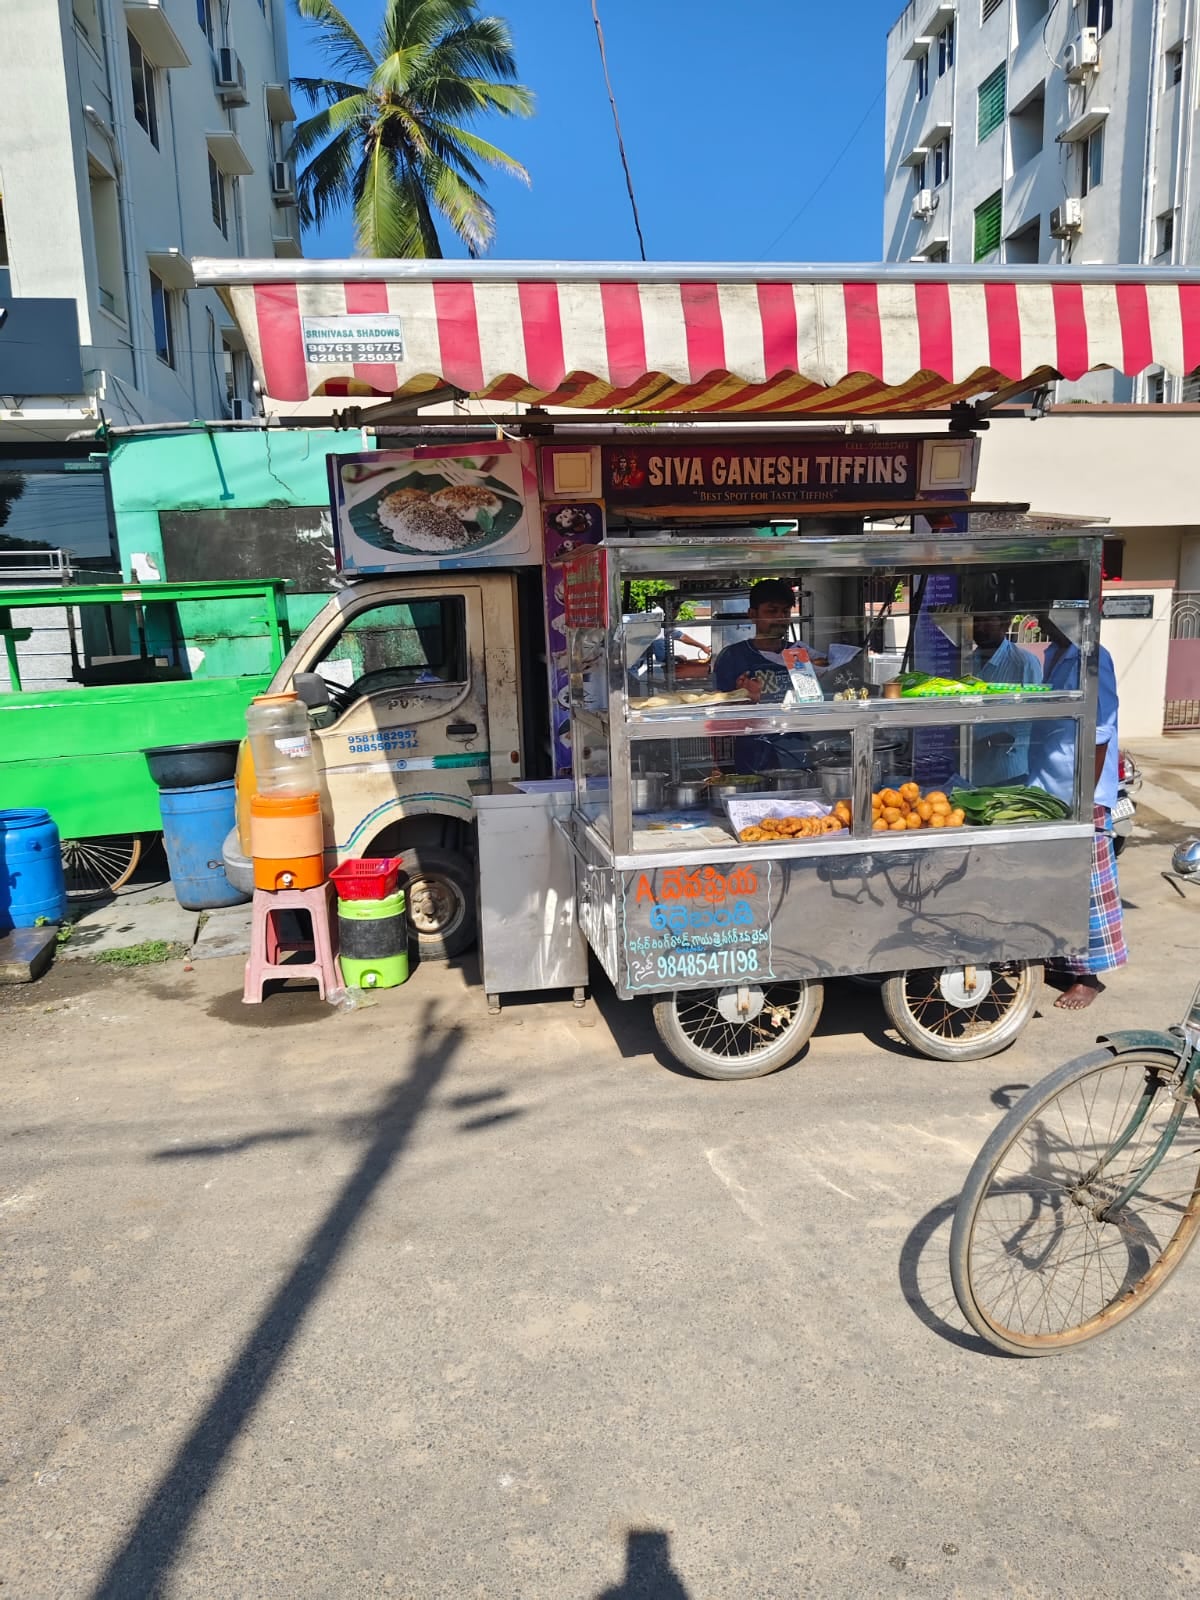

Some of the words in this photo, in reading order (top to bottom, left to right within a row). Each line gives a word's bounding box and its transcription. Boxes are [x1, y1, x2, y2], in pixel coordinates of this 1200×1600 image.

[306, 329, 354, 338] SRINIVASA
[356, 328, 400, 337] SHADOWS
[308, 344, 353, 352] 96763
[357, 343, 400, 352] 36775
[309, 354, 353, 362] 62811
[358, 353, 401, 361] 25037
[648, 456, 704, 486] SIVA
[711, 456, 809, 486] GANESH
[816, 455, 909, 484] TIFFINS
